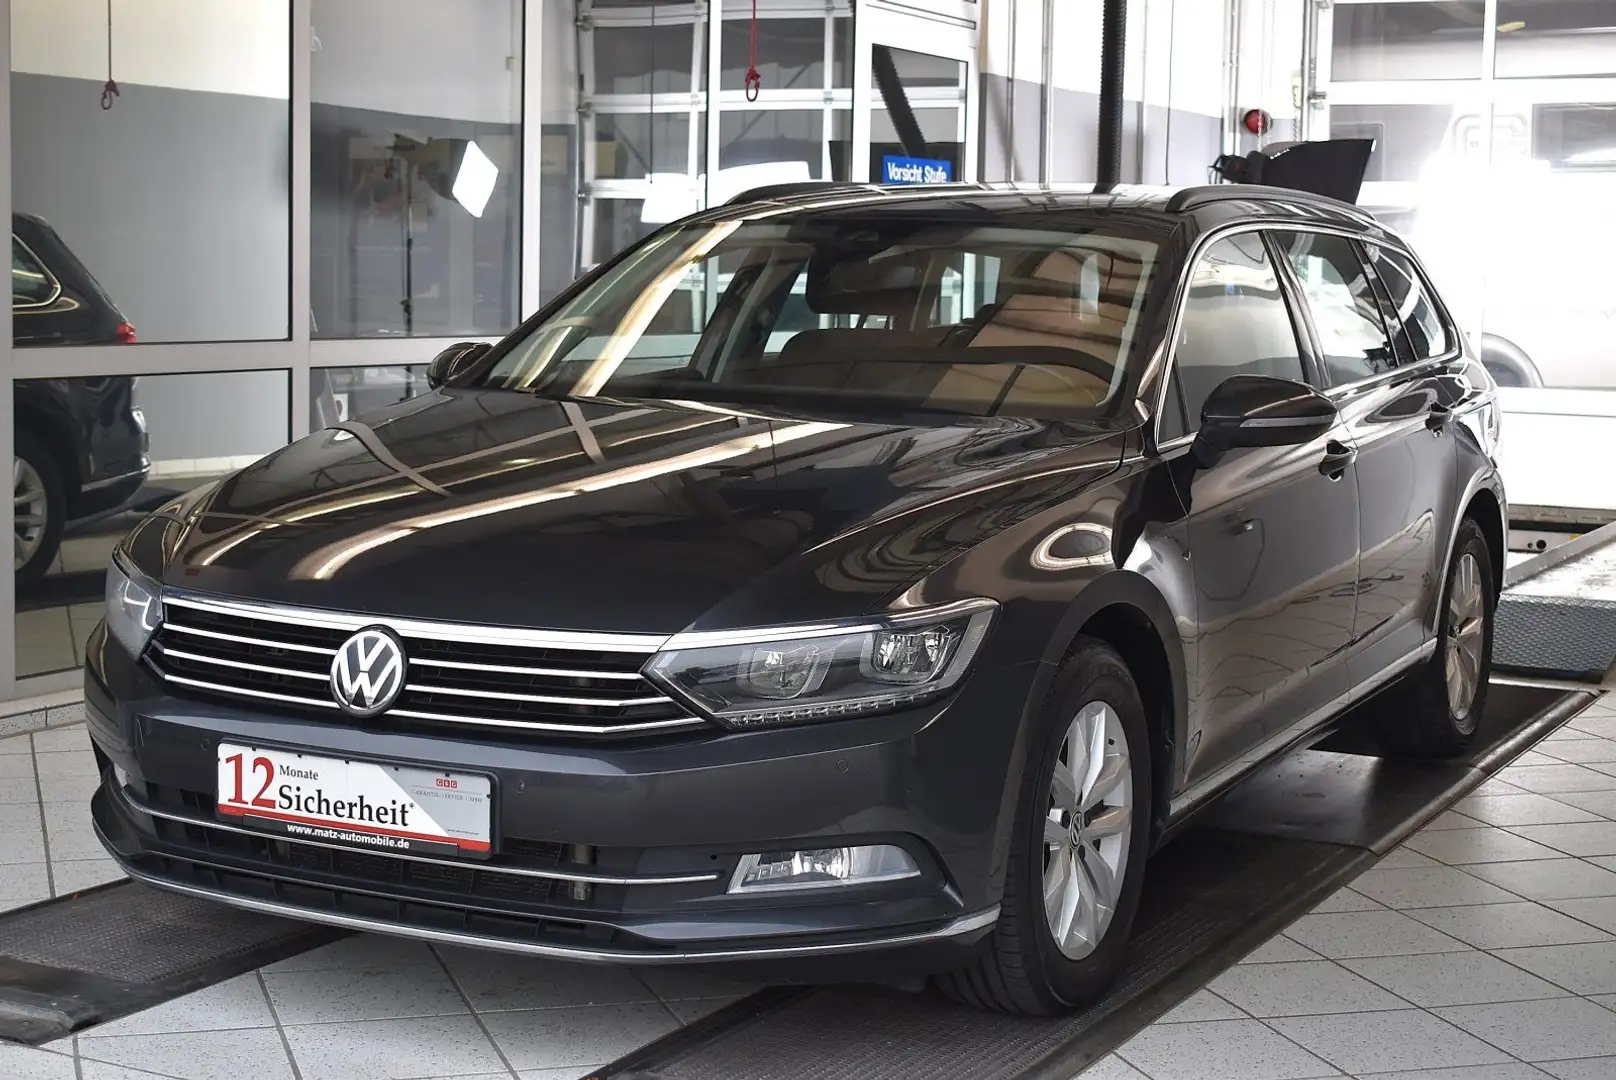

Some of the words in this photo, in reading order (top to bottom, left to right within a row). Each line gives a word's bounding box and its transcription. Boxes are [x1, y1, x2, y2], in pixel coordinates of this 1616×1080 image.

[887, 161, 923, 183] Vorsicht
[924, 164, 947, 184] Stufe
[225, 753, 276, 809] 12
[279, 764, 319, 781] Monate
[287, 823, 410, 850] www.matz-automobile.de
